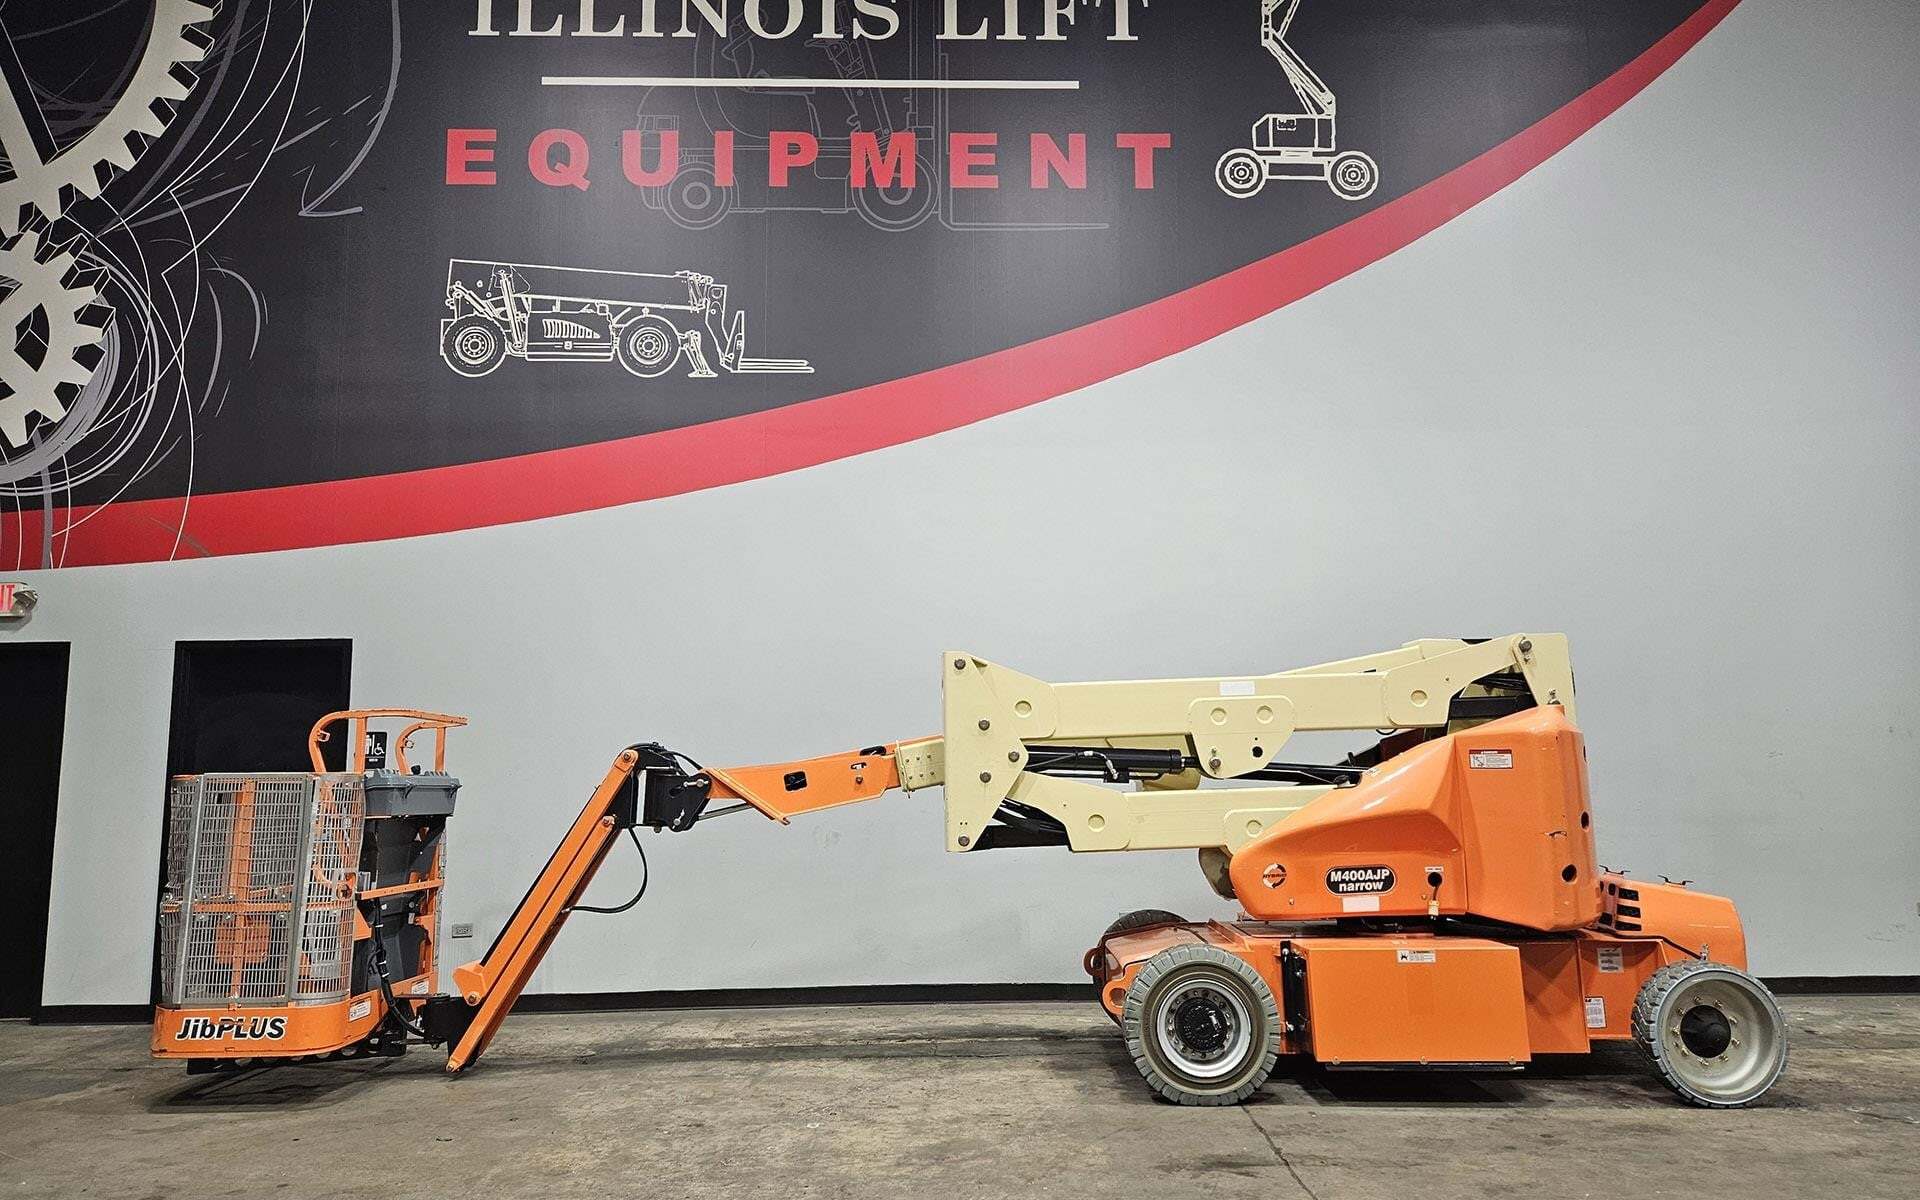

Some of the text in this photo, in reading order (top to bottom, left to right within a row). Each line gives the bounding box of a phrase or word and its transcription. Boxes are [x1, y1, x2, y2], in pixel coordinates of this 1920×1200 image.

[468, 0, 1149, 41] ILLINOIS LIFT
[445, 128, 1171, 190] EQUIPMENT
[1330, 868, 1390, 882] M400AJP
[1338, 881, 1384, 892] narrow
[175, 1016, 287, 1041] JibPLUS
